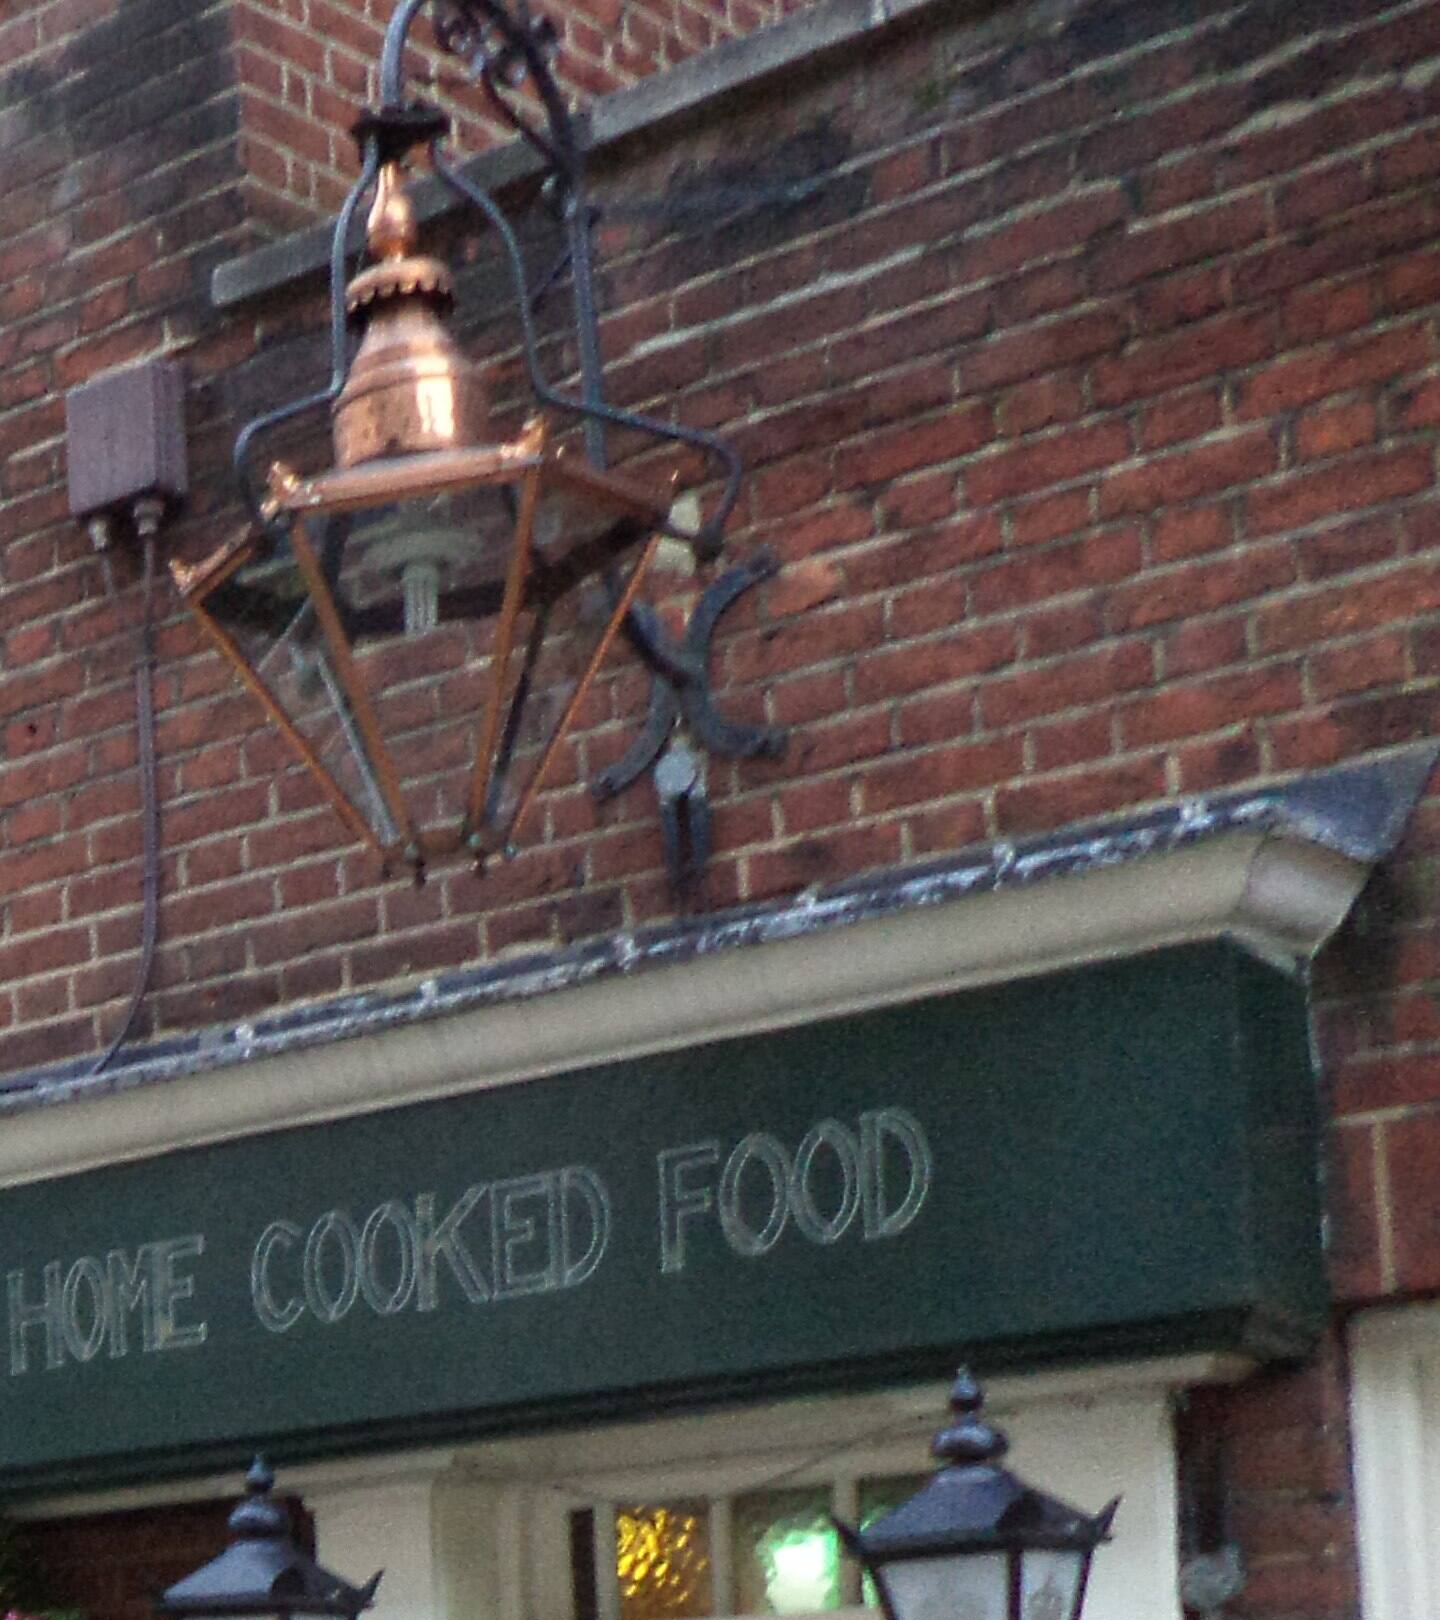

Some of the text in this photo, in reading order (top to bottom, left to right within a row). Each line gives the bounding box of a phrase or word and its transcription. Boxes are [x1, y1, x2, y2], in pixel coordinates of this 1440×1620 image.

[7, 1233, 208, 1377] HOME
[250, 1164, 614, 1336] COOKED
[656, 1106, 934, 1275] FOOD
